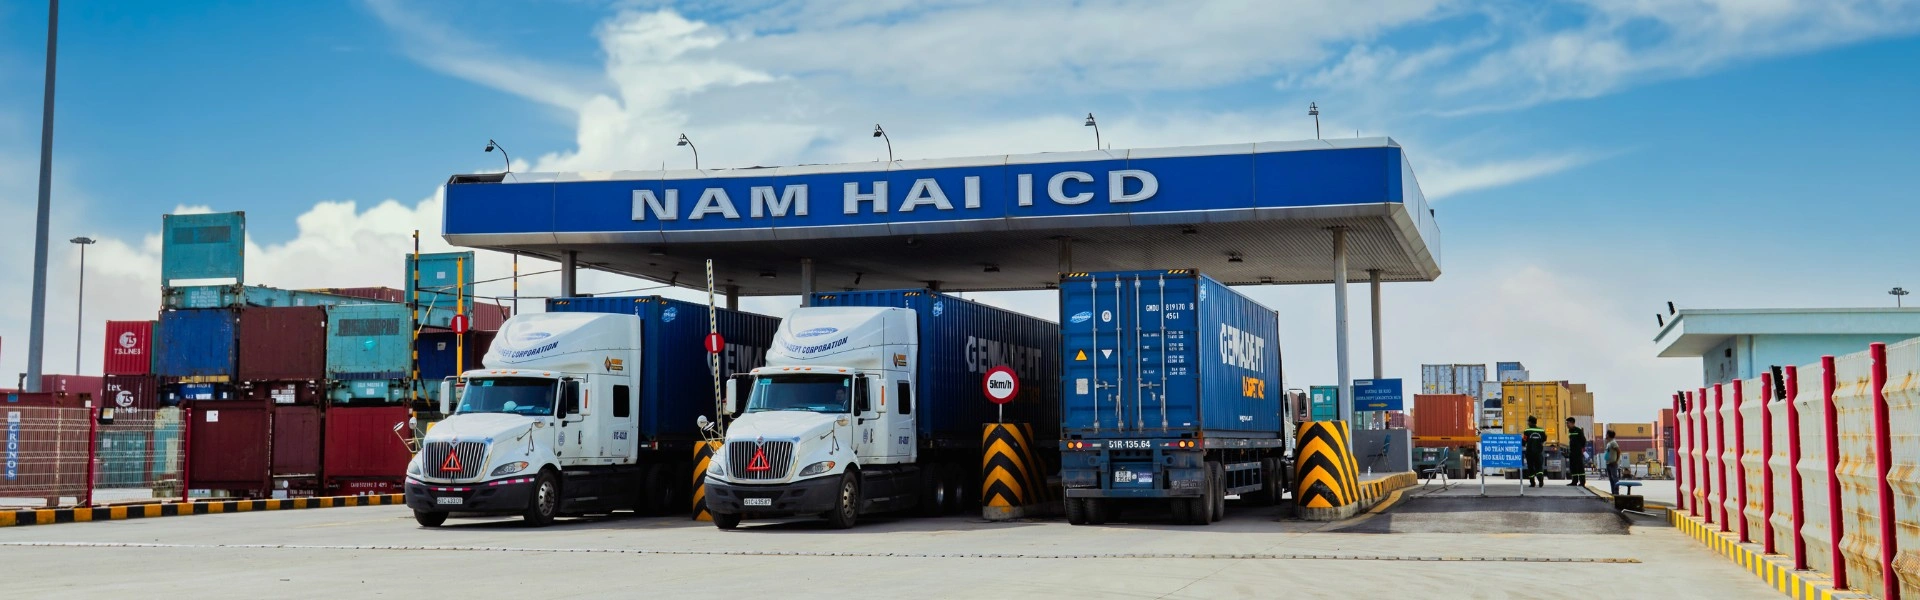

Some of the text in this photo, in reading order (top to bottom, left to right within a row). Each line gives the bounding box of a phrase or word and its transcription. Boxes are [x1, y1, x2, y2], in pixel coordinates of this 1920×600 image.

[632, 169, 1159, 221] NAM HAI ICD
[1145, 304, 1160, 312] GMDU
[1165, 303, 1186, 311] 819170
[511, 341, 559, 358] CORPORATION
[802, 336, 849, 354] CORPORATION
[107, 383, 121, 392] tex
[989, 379, 1012, 389] 5km/h
[7, 423, 18, 478] CRONOS
[1108, 440, 1151, 449] 51R-135.64
